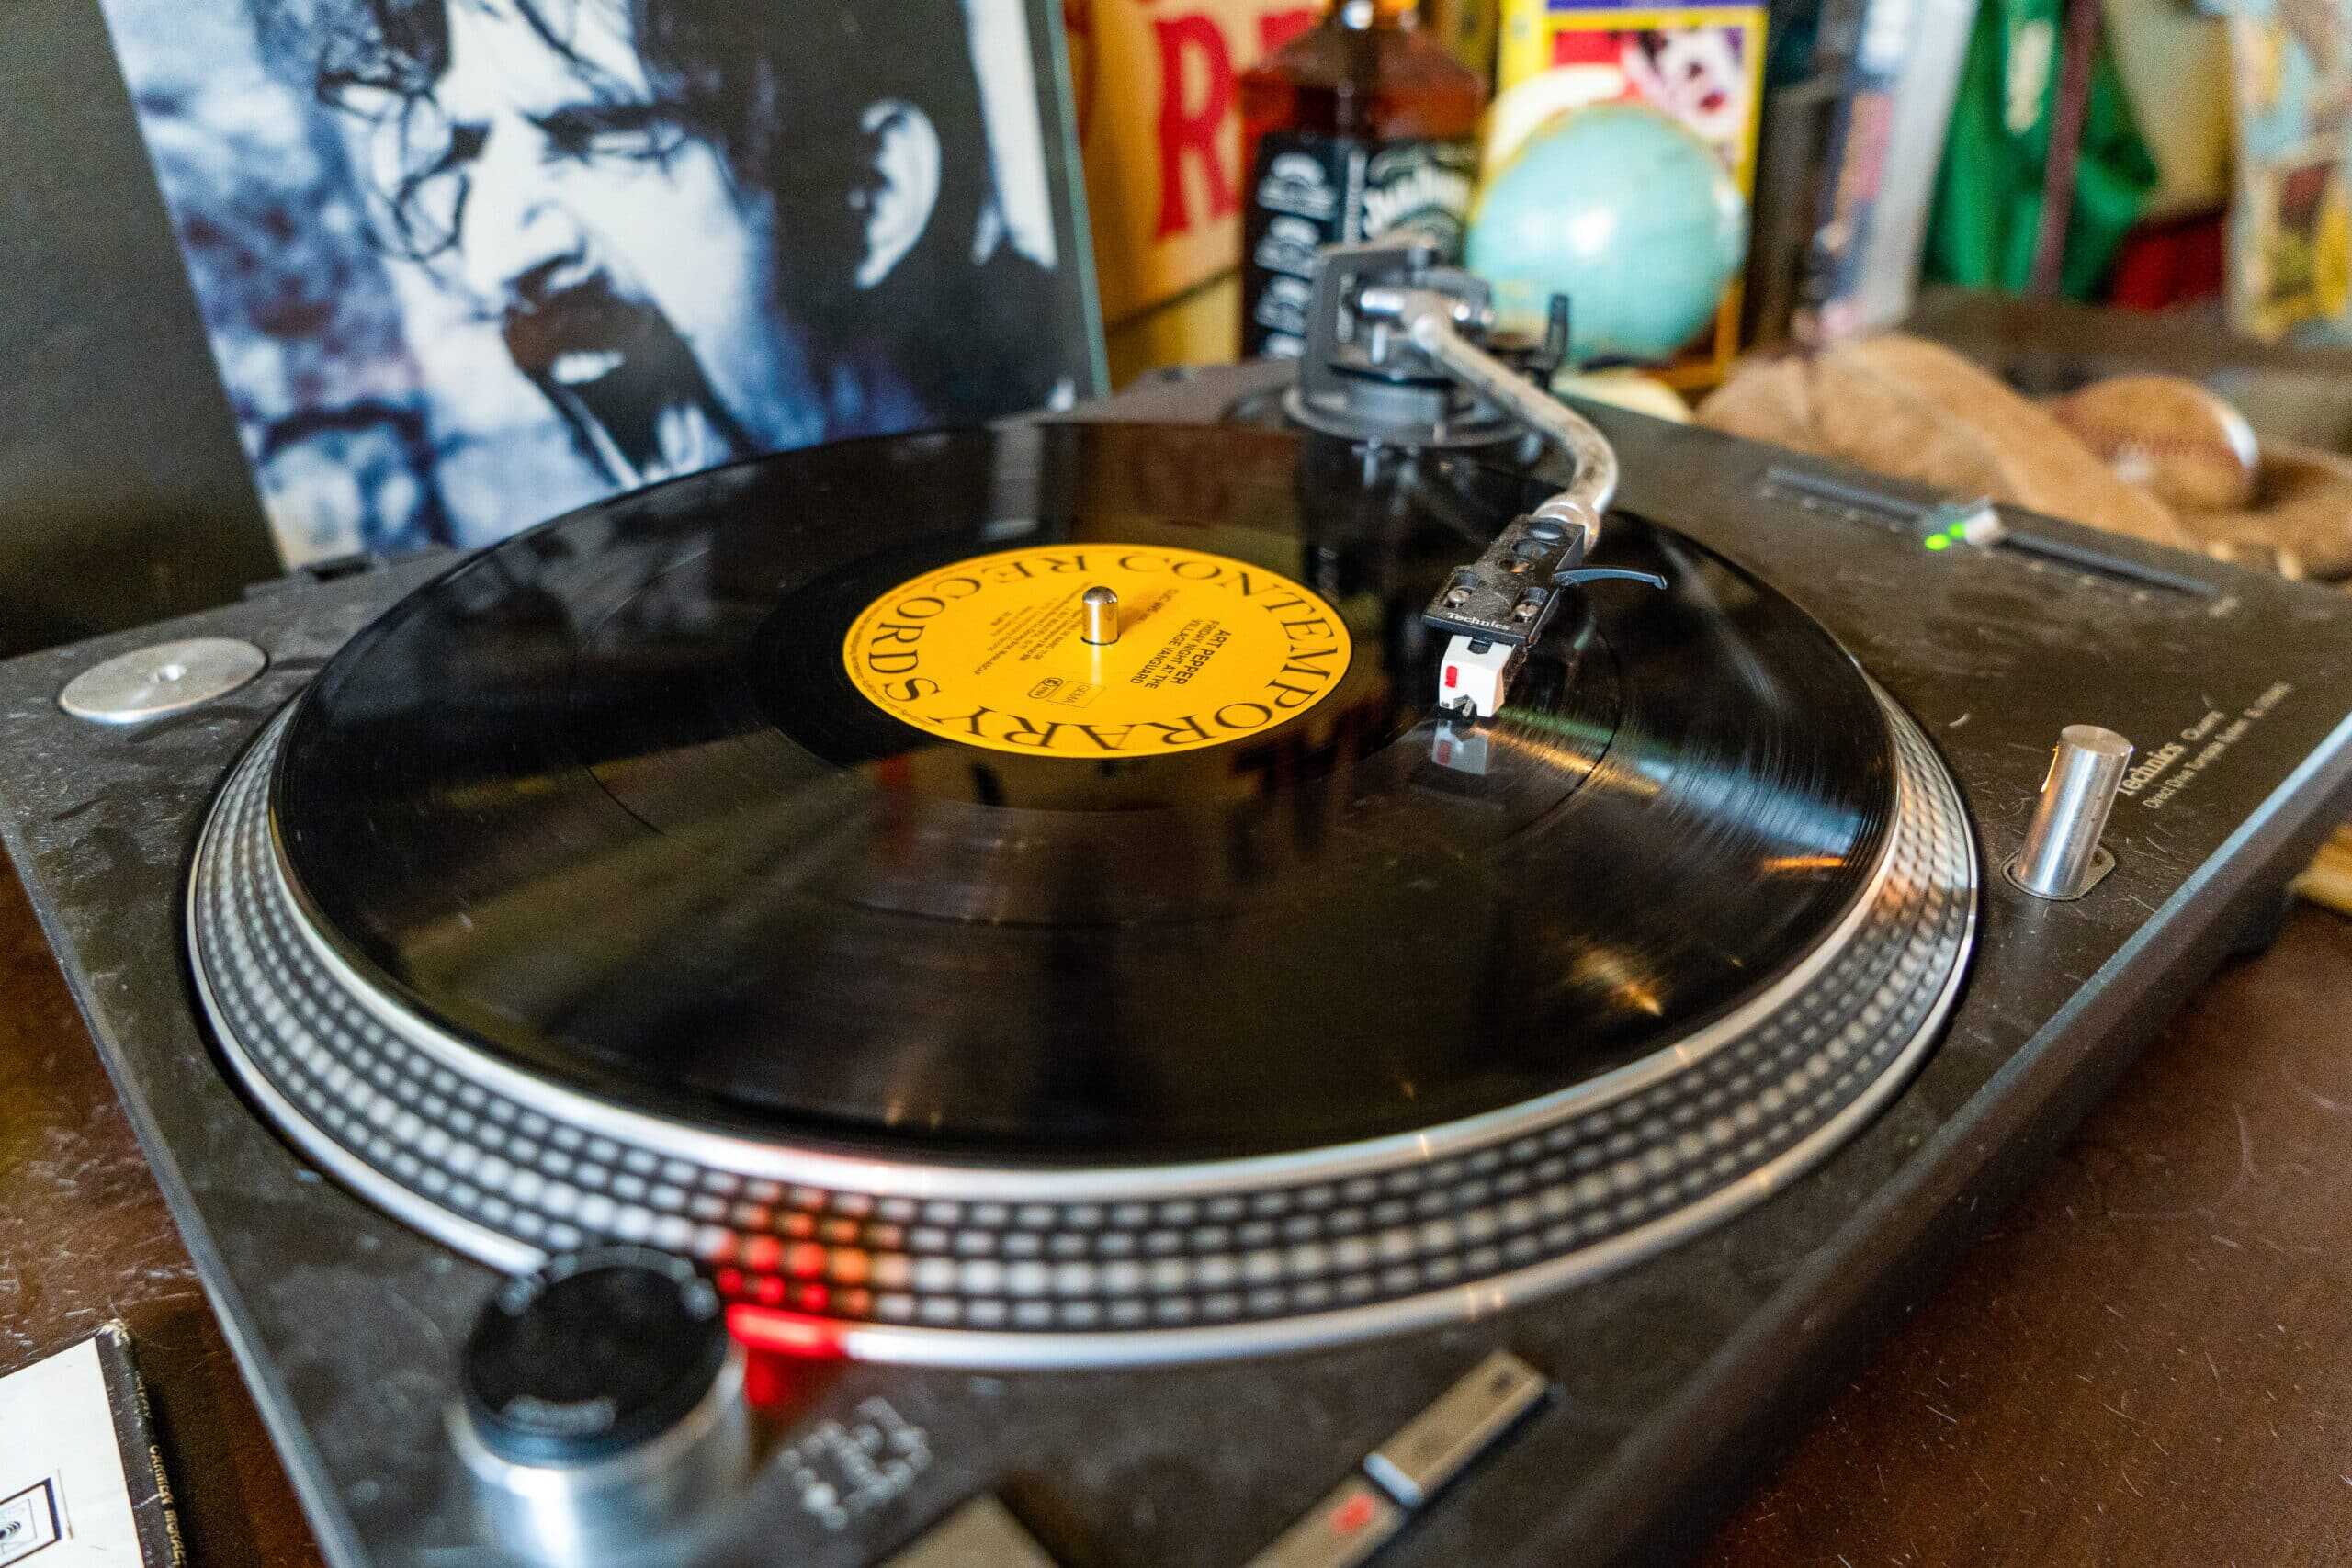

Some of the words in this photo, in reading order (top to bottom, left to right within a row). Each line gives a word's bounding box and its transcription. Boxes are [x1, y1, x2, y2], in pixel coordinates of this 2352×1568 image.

[871, 554, 1089, 704] RECORDS
[1168, 618, 1203, 647] VILLAGE
[1191, 619, 1221, 645] FRIDAY
[1447, 611, 1510, 631] Technics
[930, 553, 1340, 751] CONTEMPORARY
[1206, 629, 1232, 649] ART
[1129, 646, 1176, 684] VANGUARD
[1170, 643, 1198, 665] NIGHT
[1170, 648, 1216, 685] PEPPER
[1144, 673, 1168, 689] THE
[1160, 663, 1175, 674] AT
